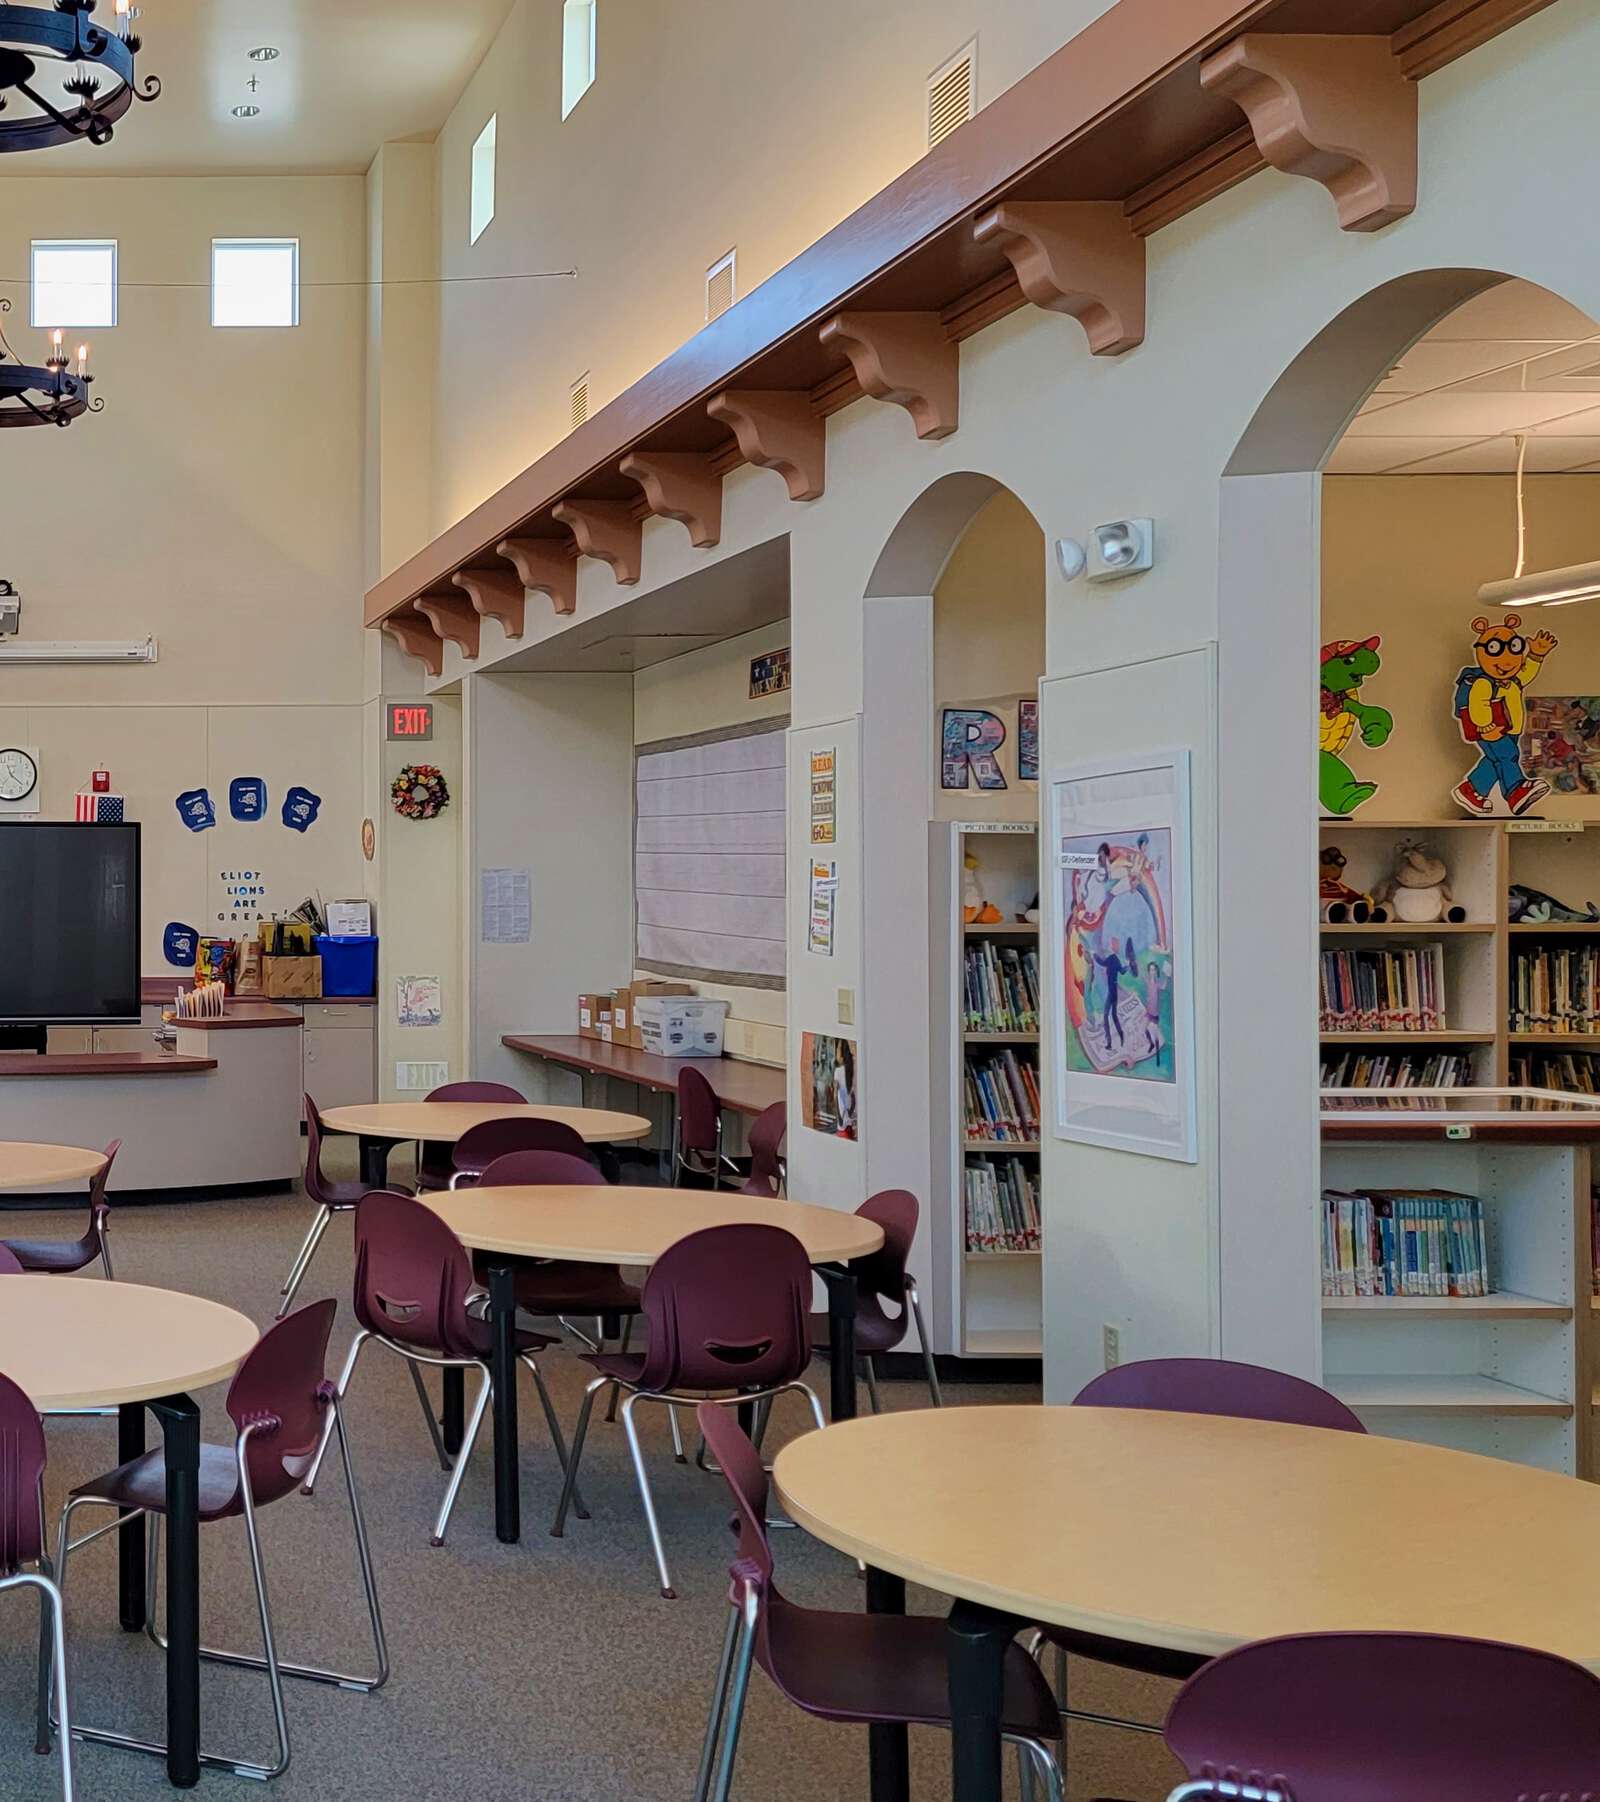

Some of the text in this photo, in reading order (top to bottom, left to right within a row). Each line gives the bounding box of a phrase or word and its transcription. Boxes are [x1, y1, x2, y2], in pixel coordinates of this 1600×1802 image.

[393, 708, 427, 734] EXIT
[220, 871, 261, 881] ELIOT
[227, 886, 265, 895] LIONS
[234, 899, 257, 908] ARE
[217, 909, 288, 921] GREAT!
